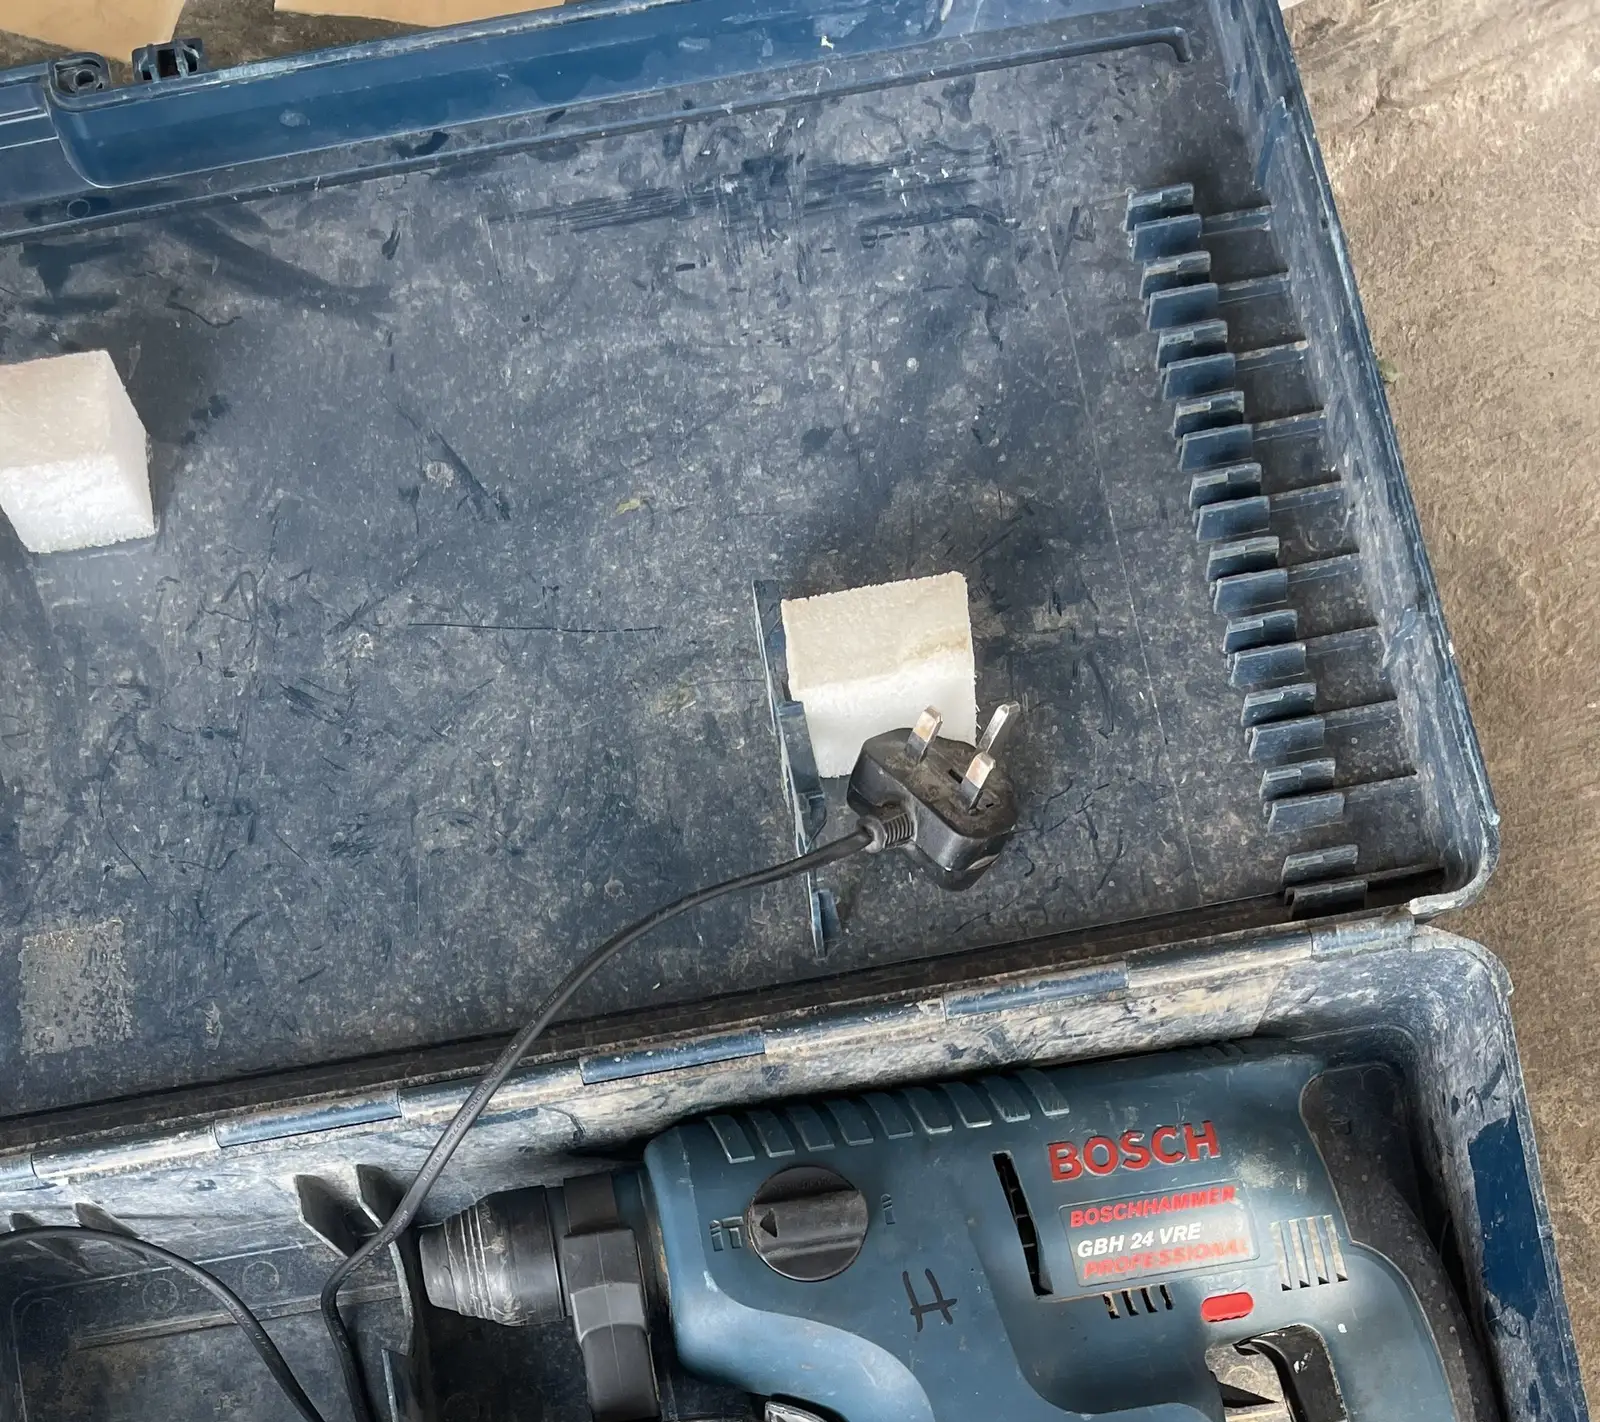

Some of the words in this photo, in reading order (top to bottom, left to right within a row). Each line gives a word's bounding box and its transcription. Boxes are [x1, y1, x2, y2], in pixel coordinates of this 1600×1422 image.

[1047, 1120, 1221, 1182] BOSCH
[1070, 1185, 1238, 1228] BOSCHHAMMER
[1077, 1232, 1125, 1258] GBH
[1130, 1228, 1155, 1251] 24
[1159, 1222, 1201, 1245] VRE
[1084, 1238, 1249, 1279] PROFESSIONAL
